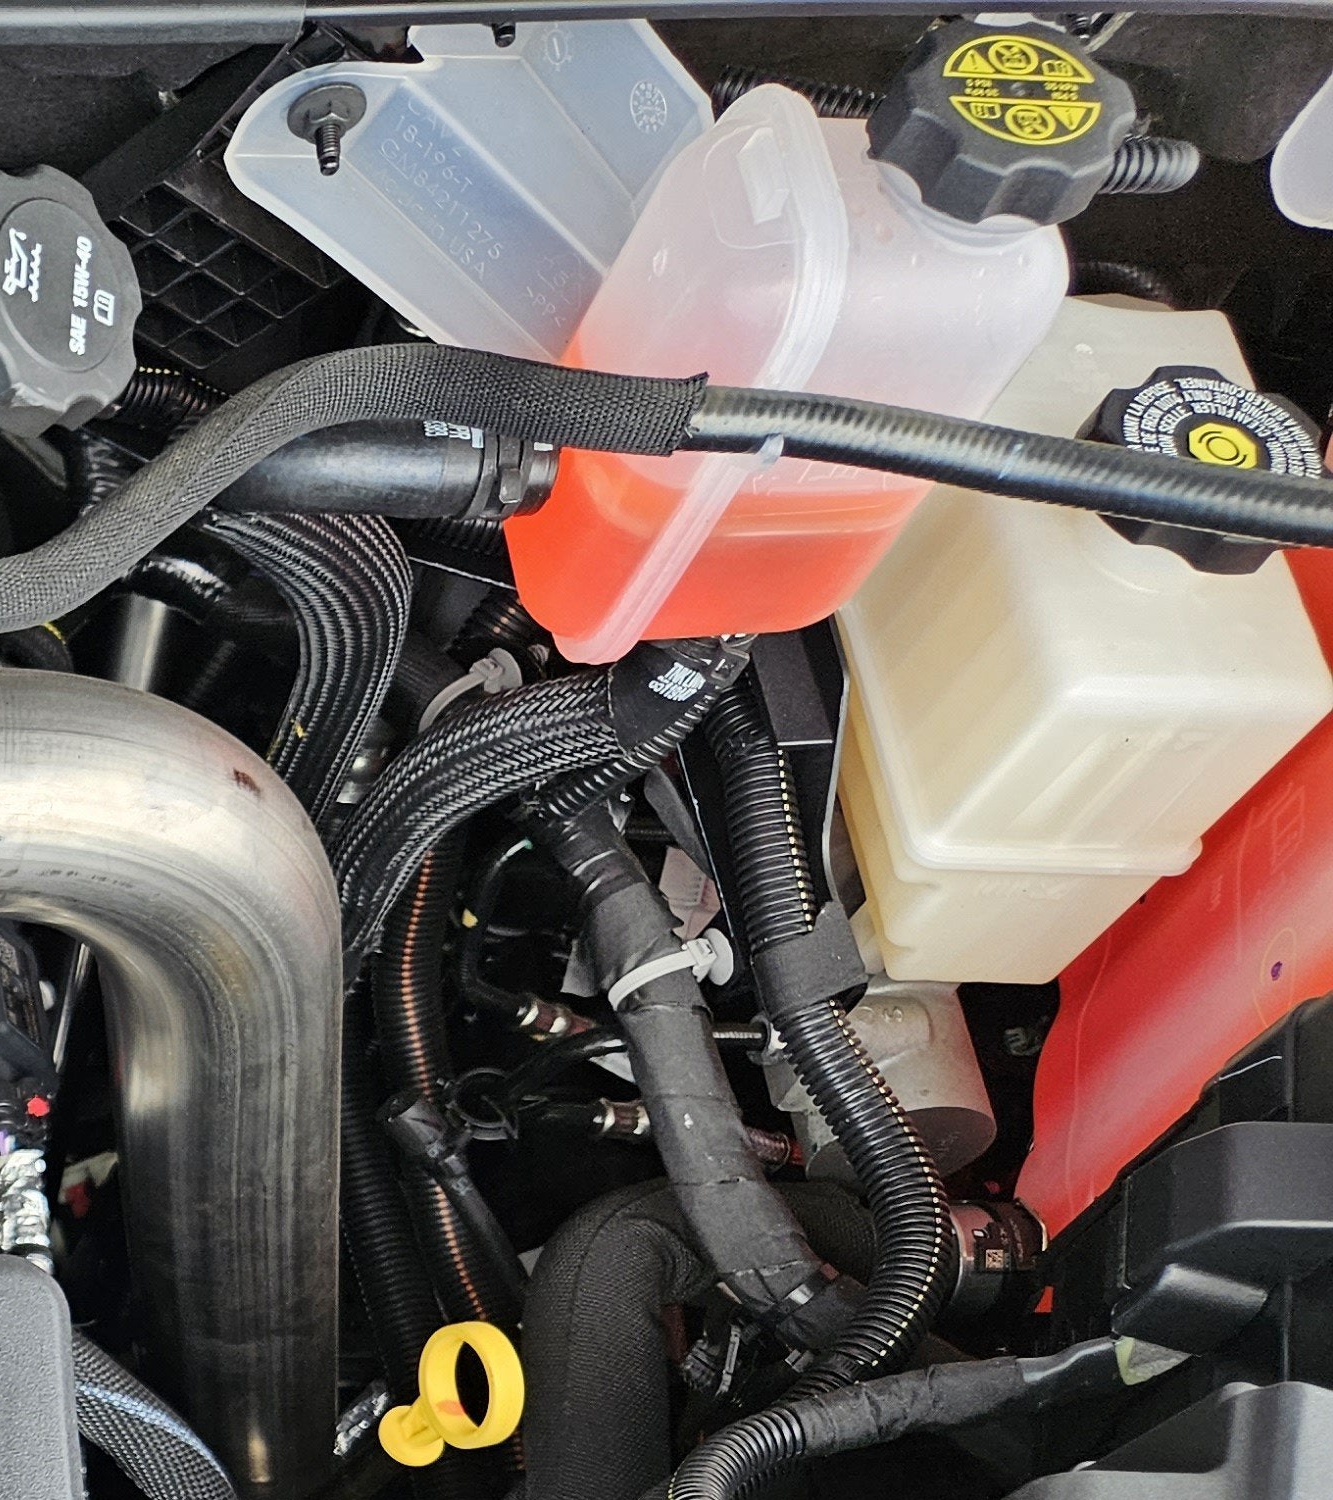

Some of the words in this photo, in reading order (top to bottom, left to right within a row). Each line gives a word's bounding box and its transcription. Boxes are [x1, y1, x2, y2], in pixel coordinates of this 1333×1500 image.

[395, 114, 473, 193] 18-196-T
[380, 137, 504, 261] GM84211275
[72, 235, 93, 308] 15W-40
[449, 235, 486, 281] USA
[68, 312, 87, 356] SAE
[1182, 389, 1214, 402] ONLY
[1190, 401, 1233, 418] FILLER
[1245, 390, 1292, 420] SEALED
[1122, 413, 1142, 445] AVANT
[1233, 411, 1271, 438] CLEAN
[1290, 425, 1316, 452] FROM
